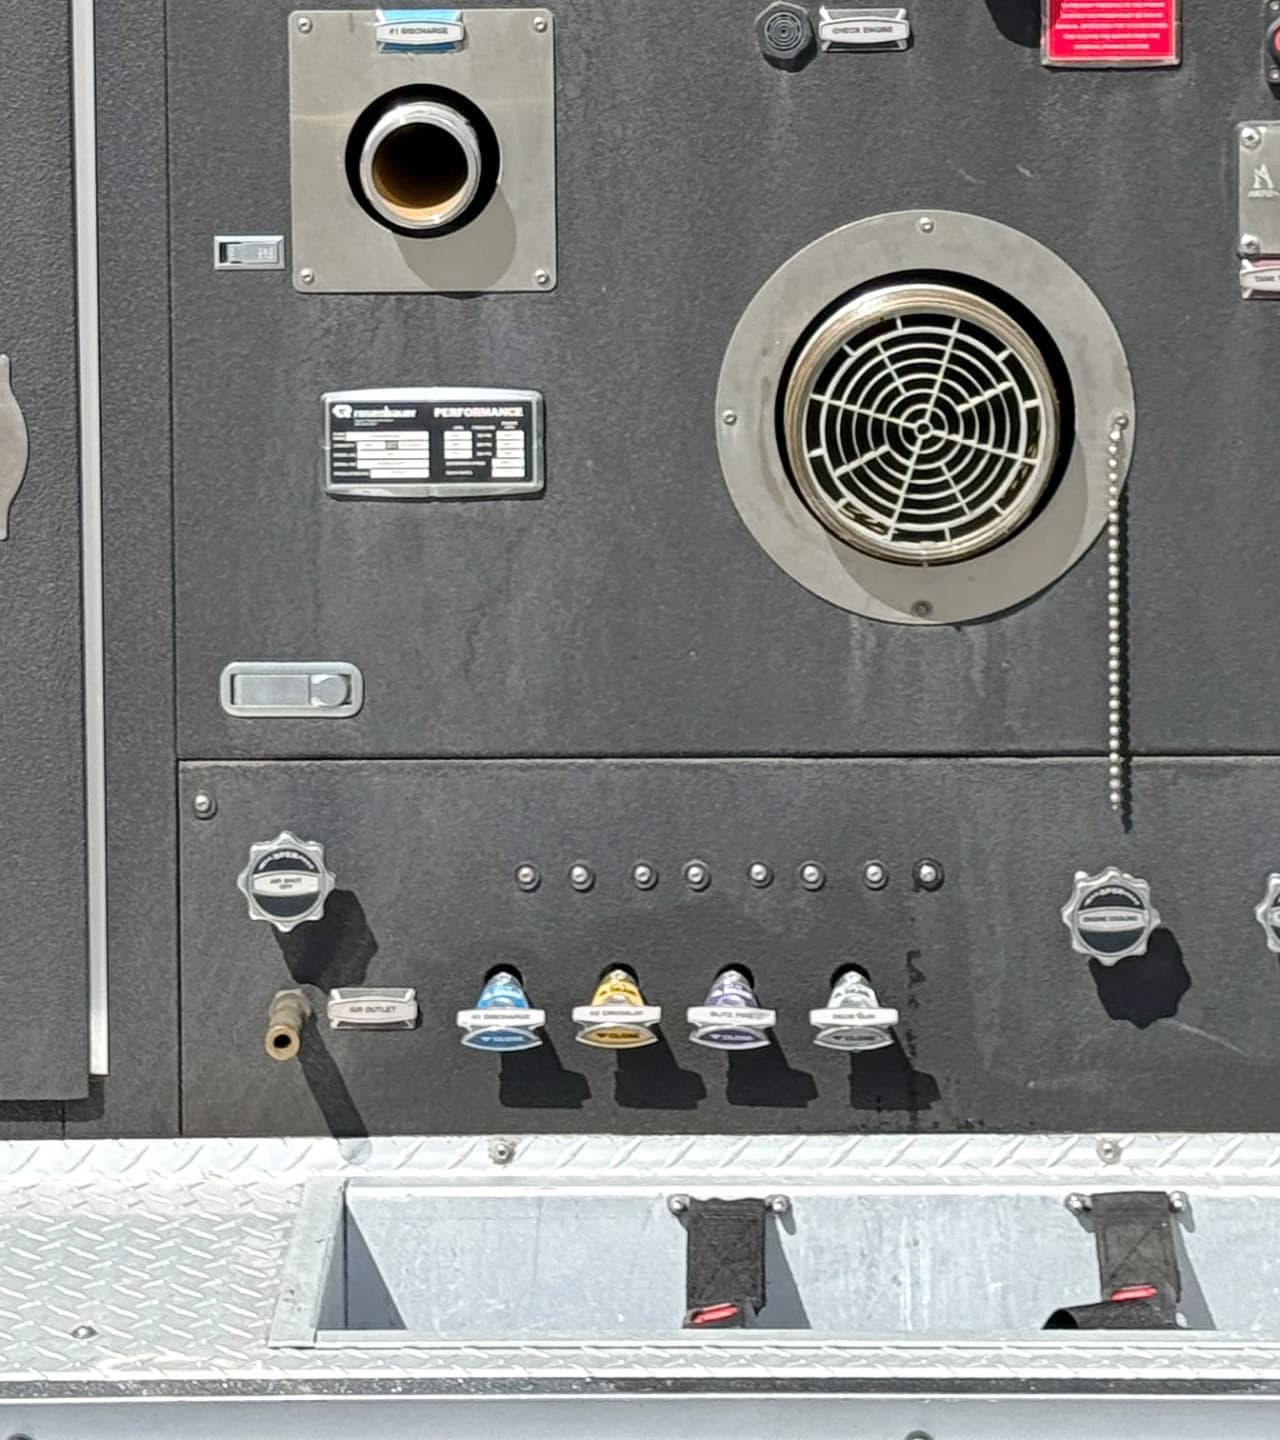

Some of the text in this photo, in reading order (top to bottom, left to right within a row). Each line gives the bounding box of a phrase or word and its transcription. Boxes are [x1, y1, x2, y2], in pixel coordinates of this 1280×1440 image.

[401, 26, 448, 35] DISCHARGE
[832, 25, 893, 35] CHECK ENGINE
[434, 407, 524, 417] PERFORMANCE
